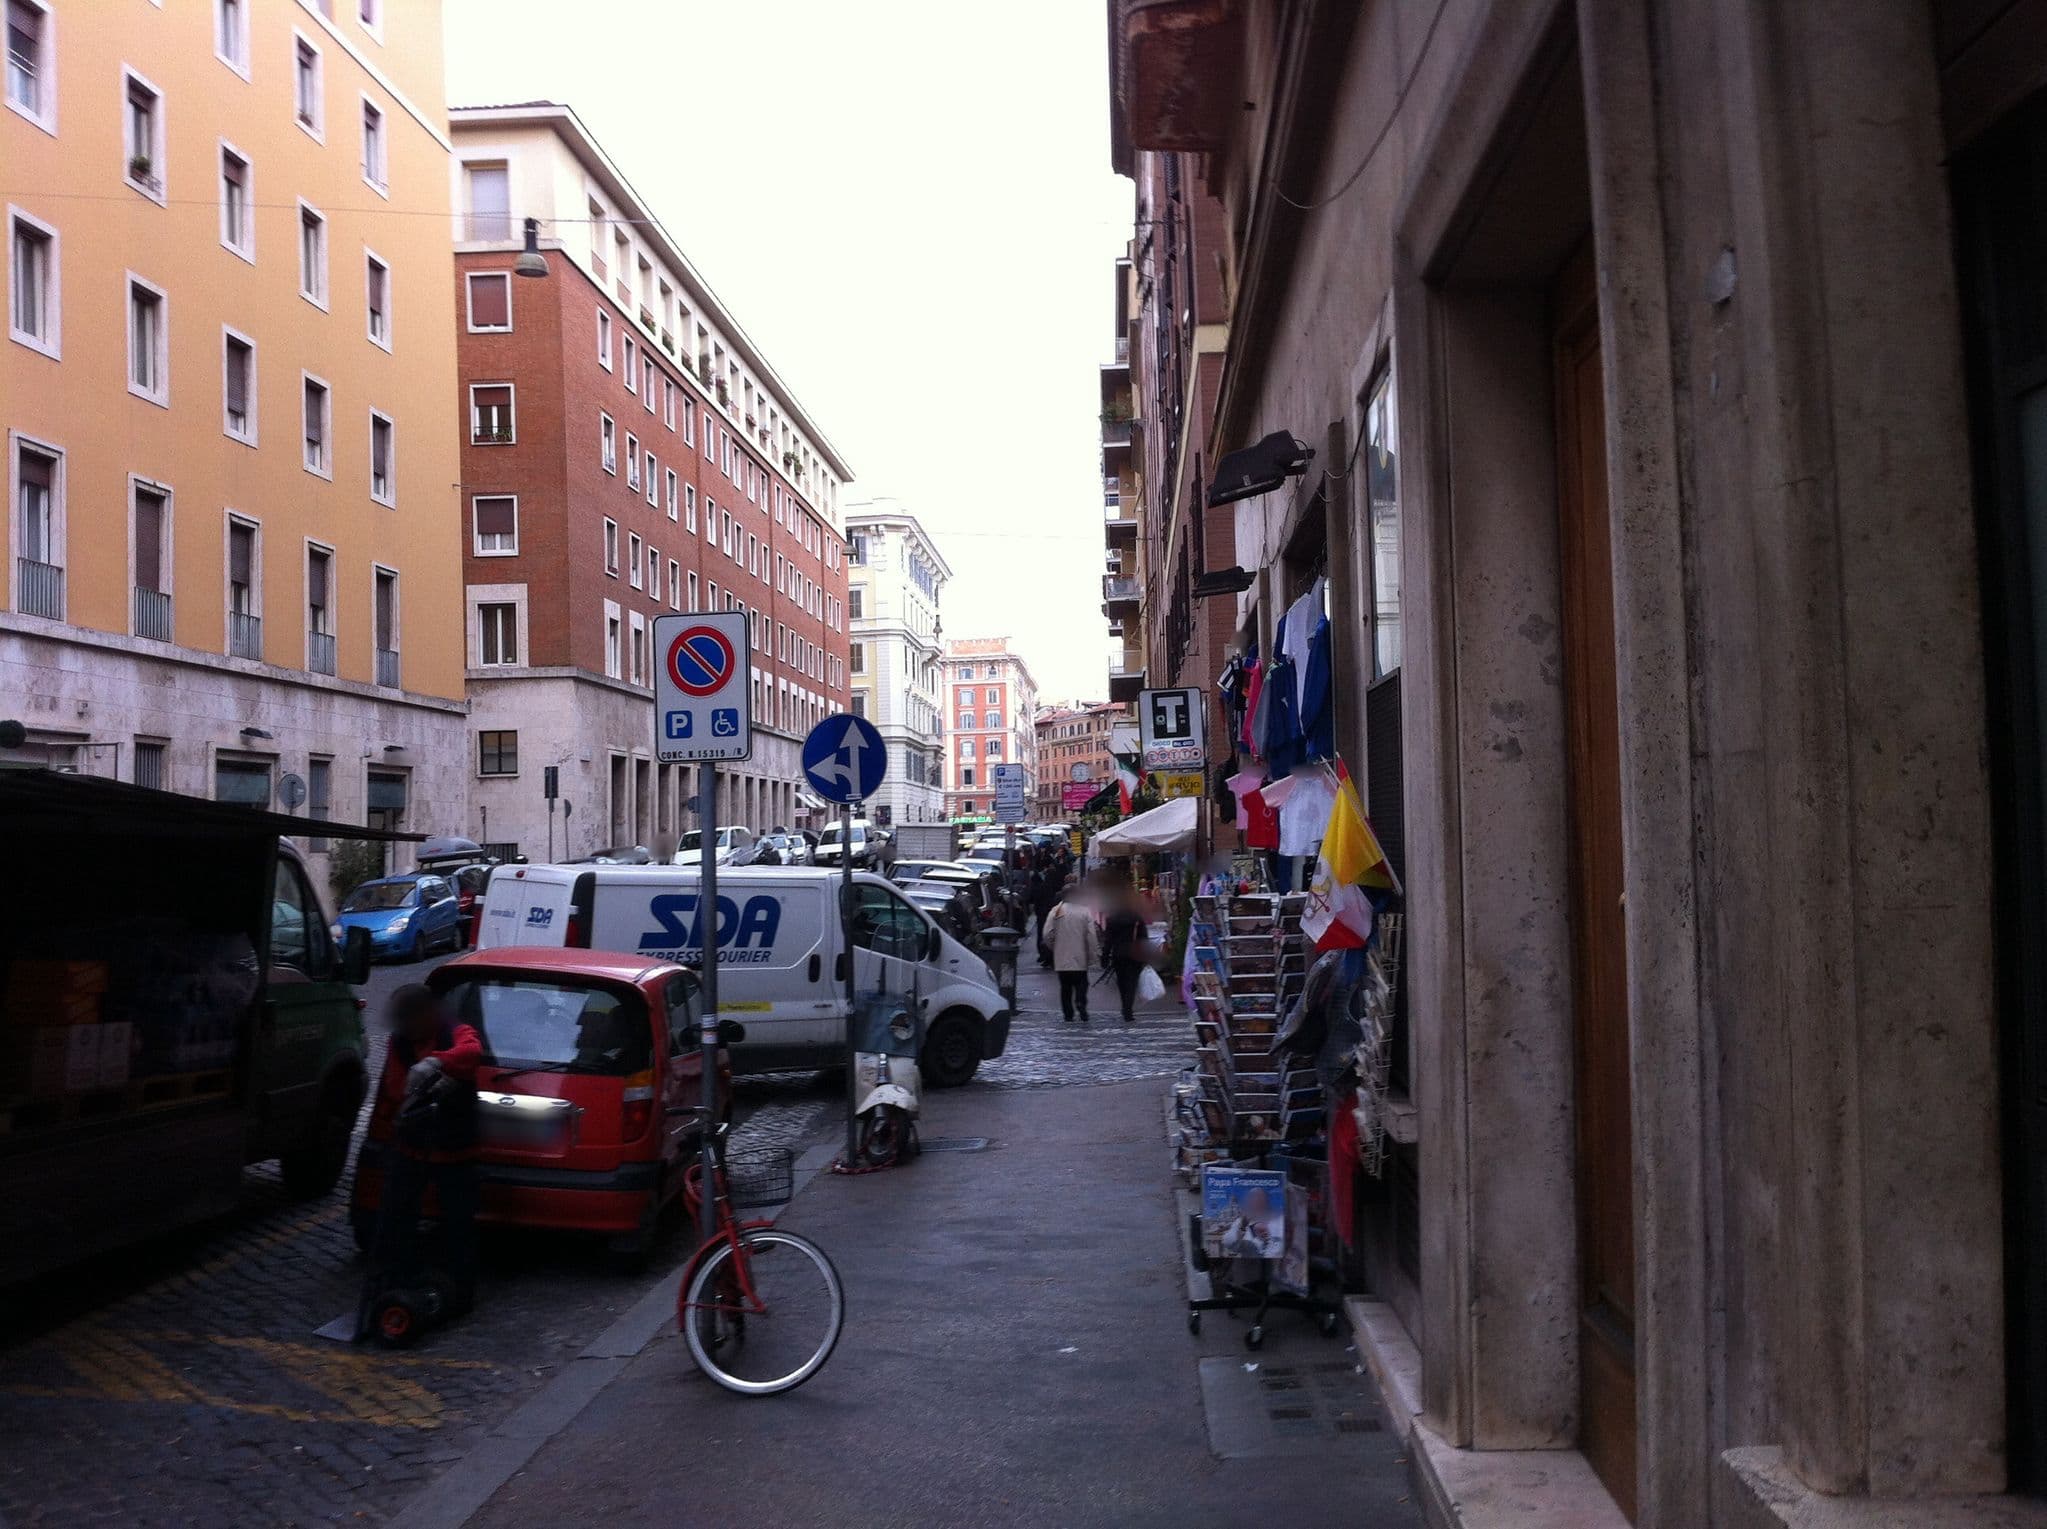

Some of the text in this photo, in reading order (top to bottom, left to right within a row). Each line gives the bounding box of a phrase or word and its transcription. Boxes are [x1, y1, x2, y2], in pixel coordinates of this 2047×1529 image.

[672, 713, 688, 736] P
[1156, 696, 1184, 733] T
[527, 906, 553, 924] SDA
[639, 894, 781, 949] SDA
[717, 950, 772, 963] OURIER
[1208, 1177, 1231, 1188] Papa
